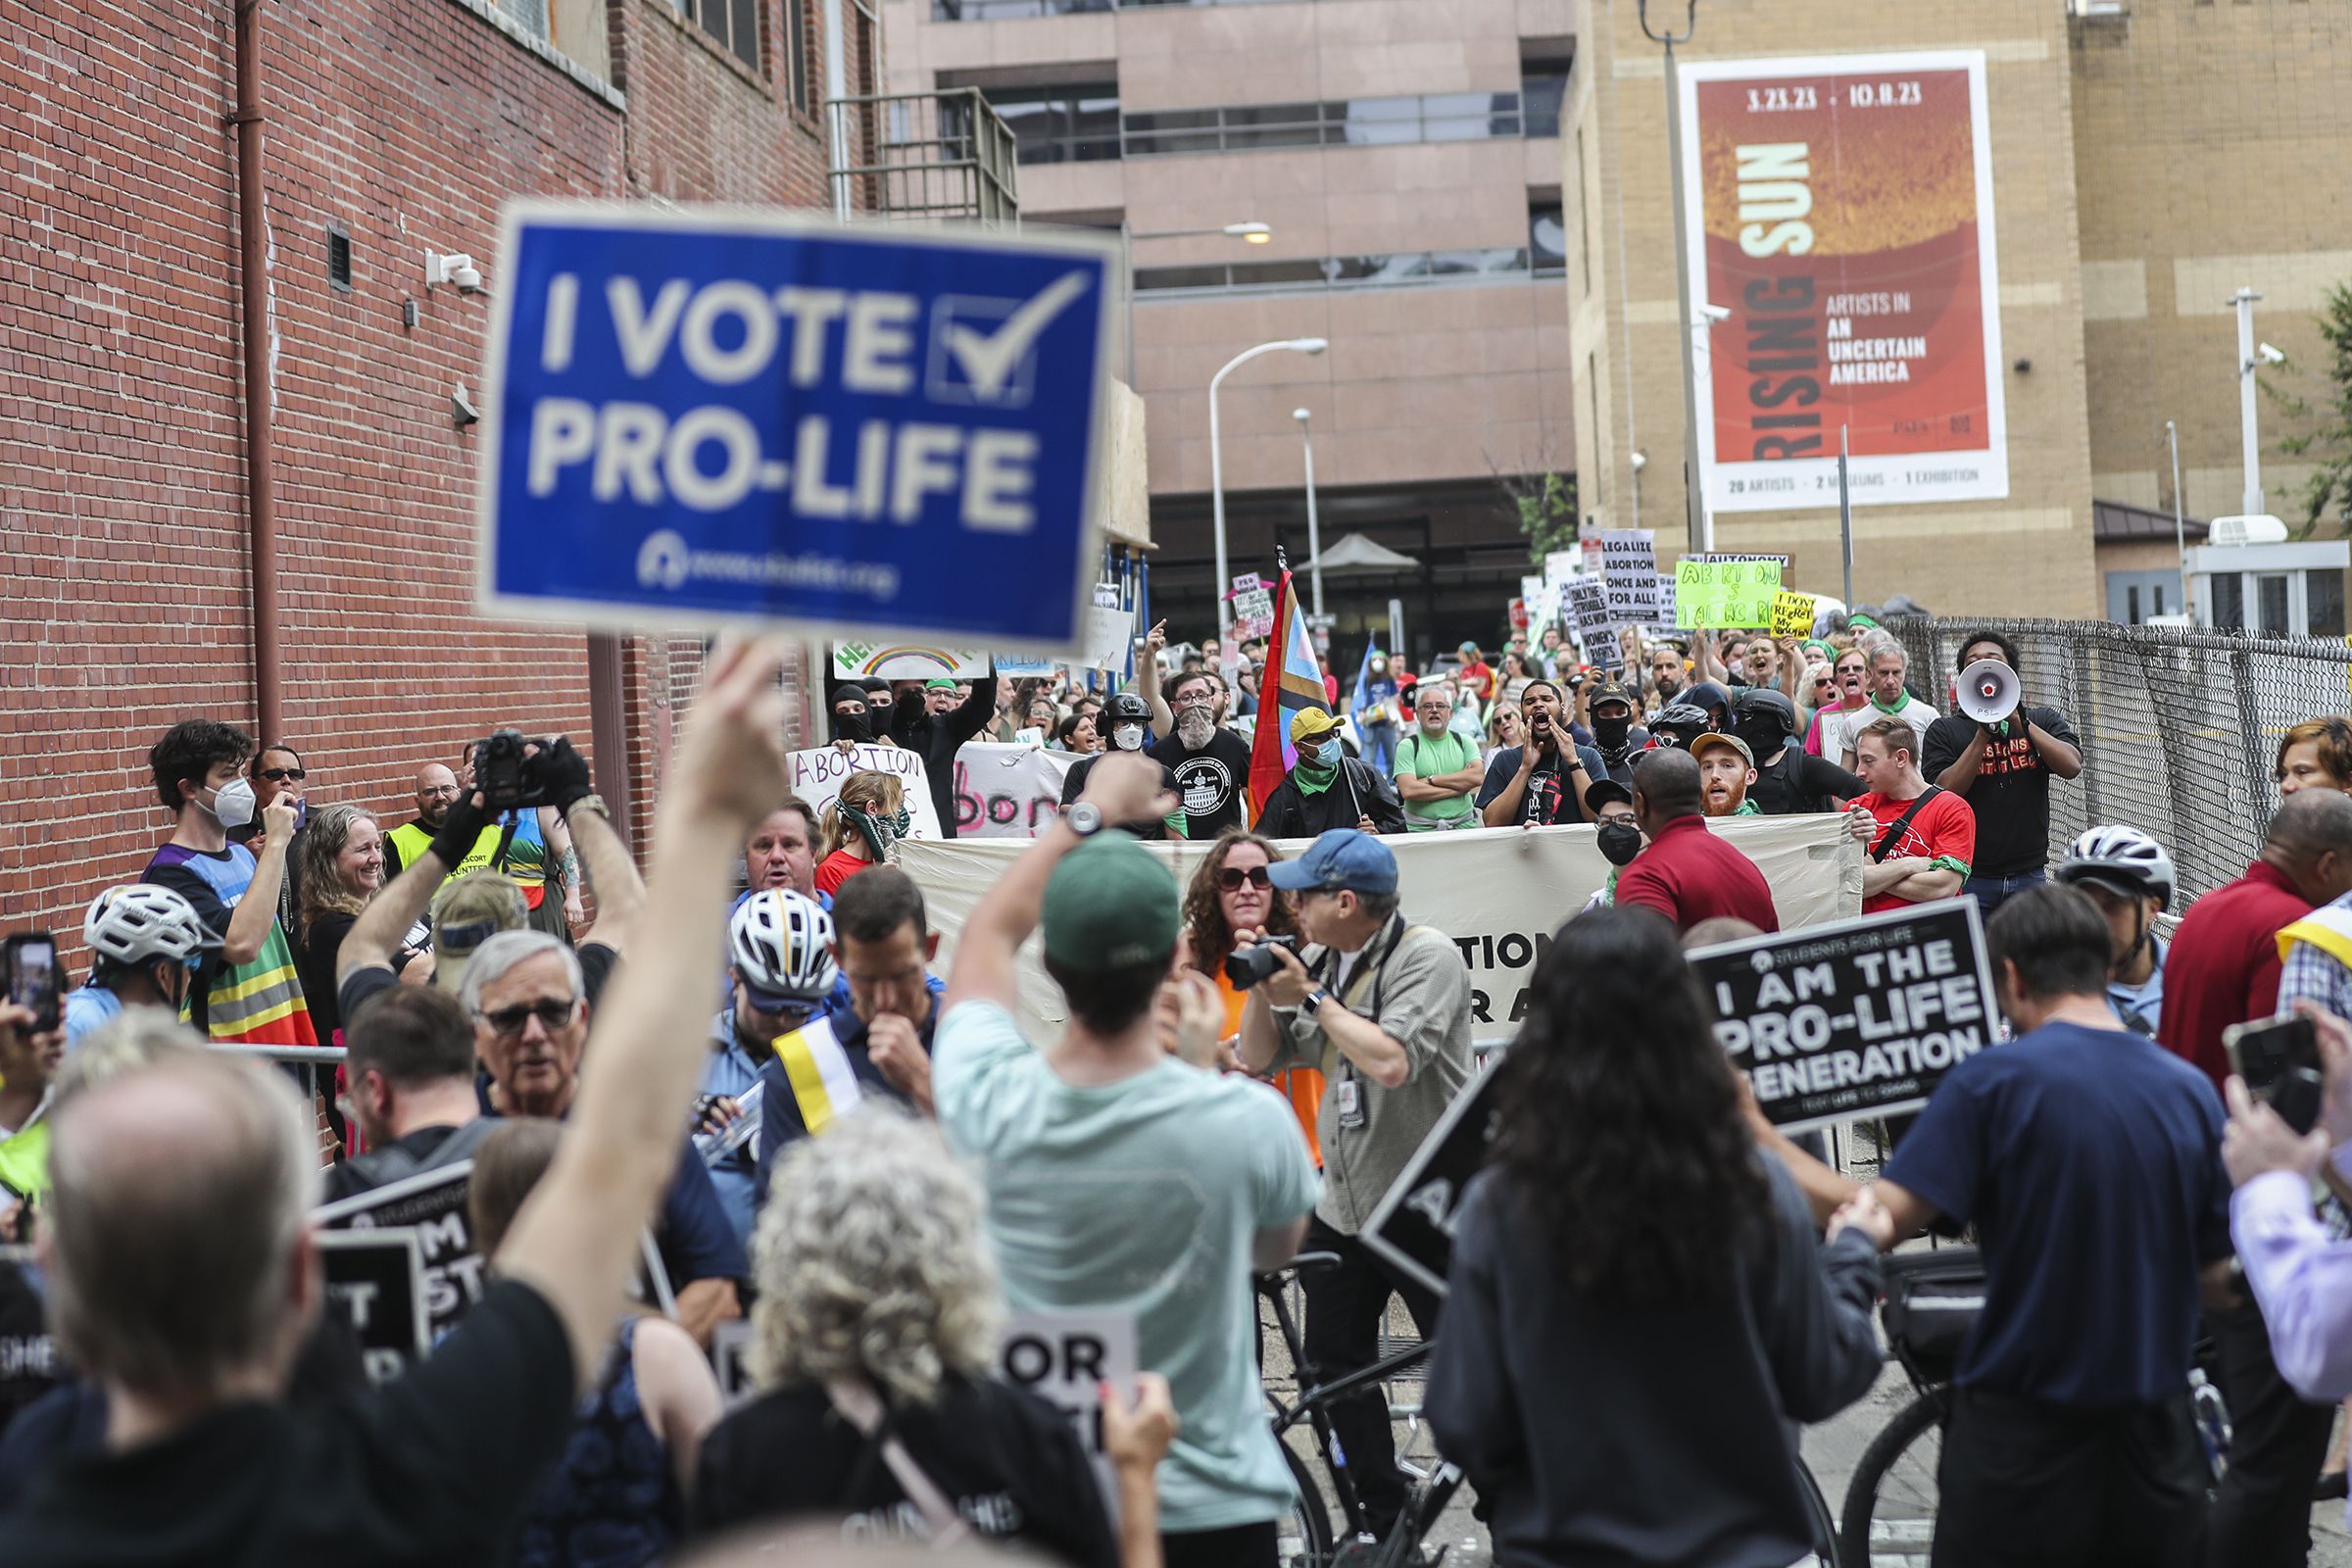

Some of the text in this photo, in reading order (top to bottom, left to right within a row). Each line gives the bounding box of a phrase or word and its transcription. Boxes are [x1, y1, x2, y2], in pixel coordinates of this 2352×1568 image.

[1746, 86, 1818, 113] 3.23.23
[1736, 142, 1823, 461] RISING SUN
[1826, 291, 1911, 316] ARTISTS IN
[541, 271, 920, 394] I VOTE
[1828, 318, 1852, 339] AN
[1828, 336, 1927, 362] UNCERTAIN
[1829, 360, 1910, 385] AMERICA
[526, 397, 1039, 535] PRO-LIFE
[1729, 479, 1744, 493] 20
[1749, 476, 1794, 492] ARTISTS
[1817, 475, 1824, 489] 2
[1829, 472, 1885, 488] MSEUMS
[1916, 468, 1980, 485] EXHIBITION
[1602, 541, 1652, 552] LEGALIZE
[1605, 560, 1654, 570] ABORTION
[1606, 578, 1634, 588] ONCE
[1636, 578, 1656, 588] AND
[1574, 598, 1607, 614] STRUGGLE
[1609, 593, 1655, 604] FOR ALL!
[1583, 629, 1616, 647] WOMEN'S
[1978, 708, 2000, 716] PSL
[796, 747, 919, 787] ABORTION
[1775, 938, 1850, 967] STUDENTS
[1884, 925, 1916, 943] LIFE
[1715, 939, 1958, 1016] I AM THE
[1712, 974, 1984, 1061] PRO-LIFE
[1746, 1026, 1983, 1102] ENERATION
